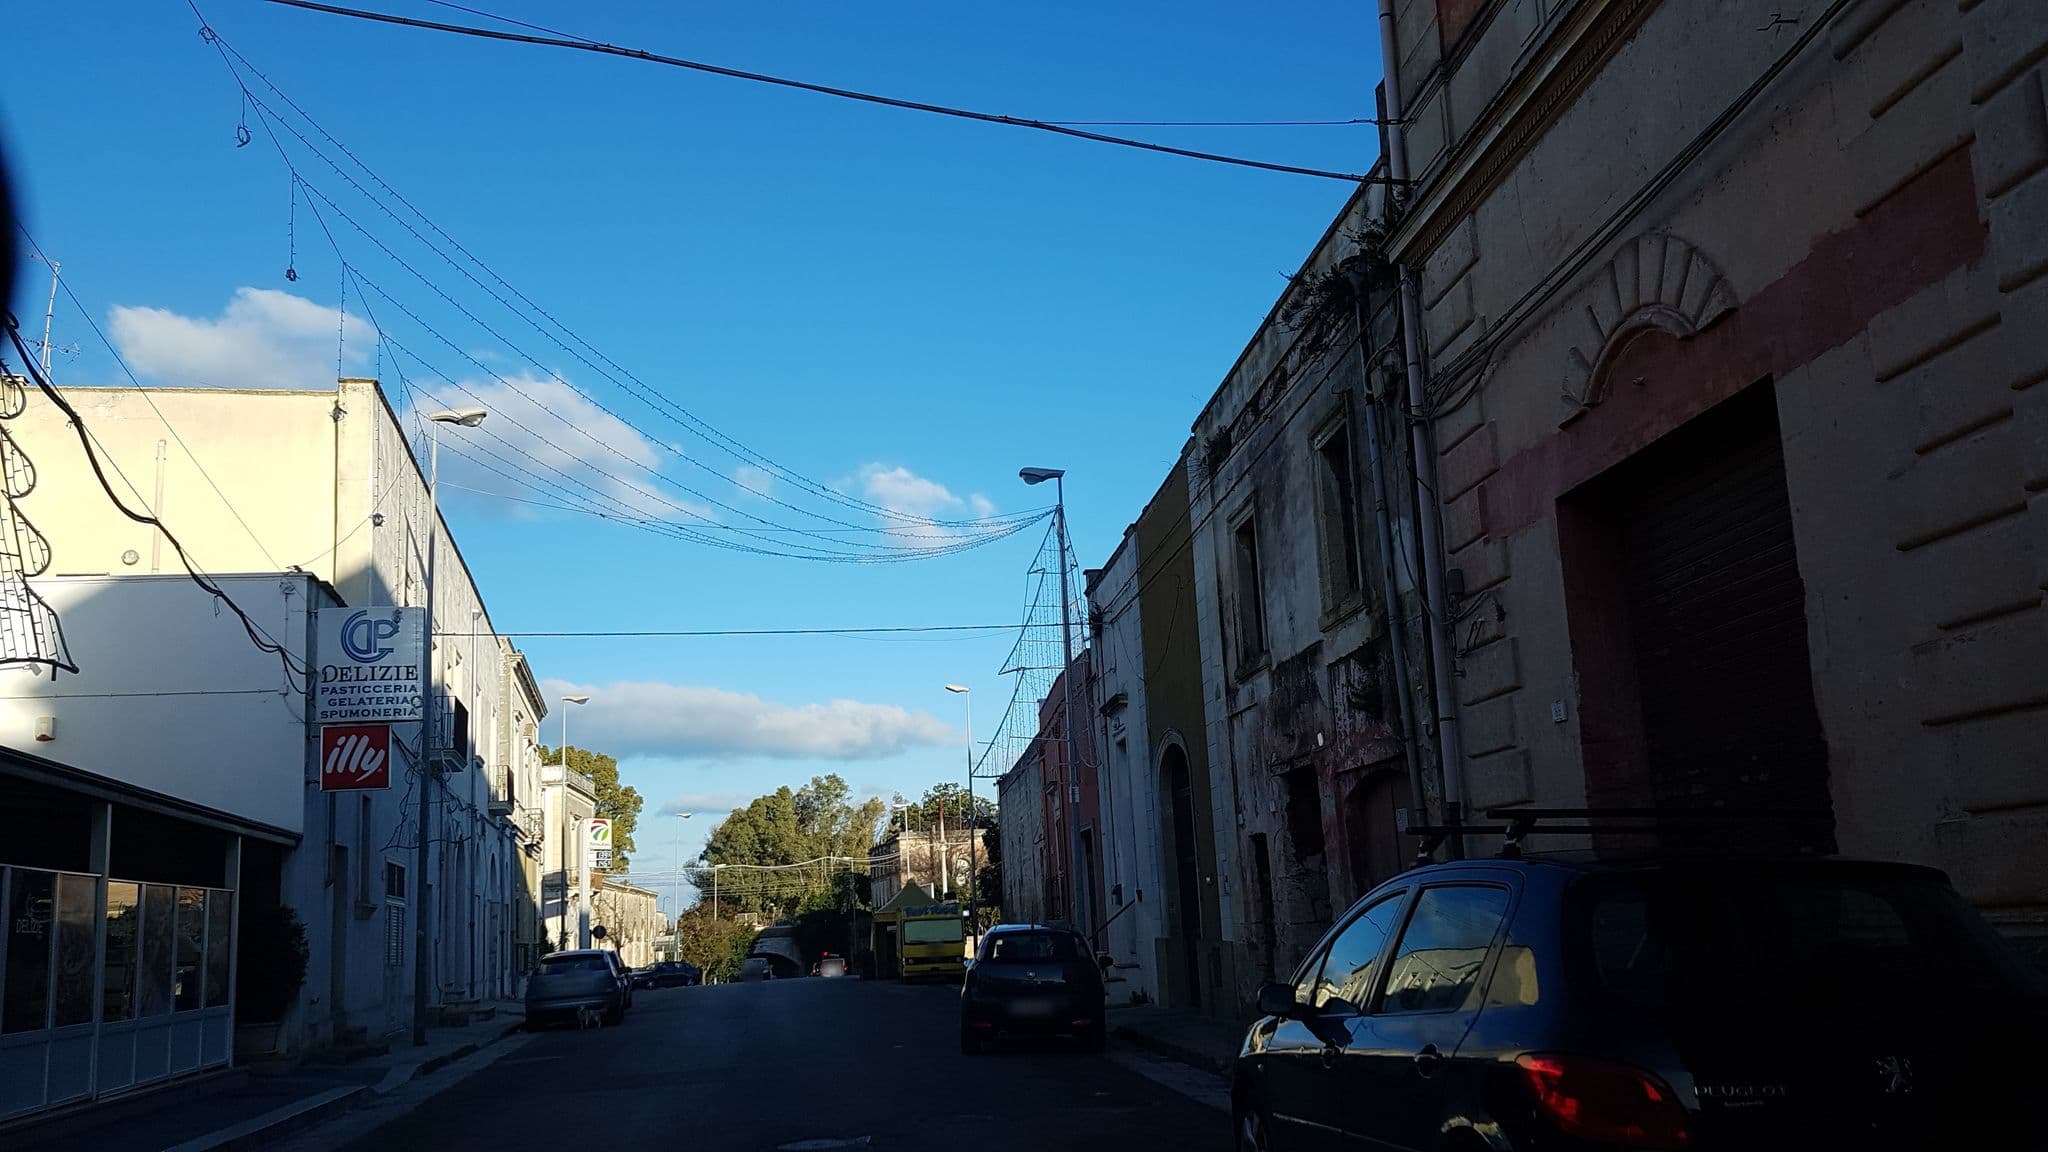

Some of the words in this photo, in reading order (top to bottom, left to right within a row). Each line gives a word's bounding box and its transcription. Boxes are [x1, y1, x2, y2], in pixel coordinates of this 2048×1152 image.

[321, 665, 418, 683] DELIZIE
[321, 684, 418, 695] PASTICCERIA
[327, 696, 411, 707] GELATERIA
[320, 708, 418, 719] SPUMONERIA
[325, 734, 385, 782] illy
